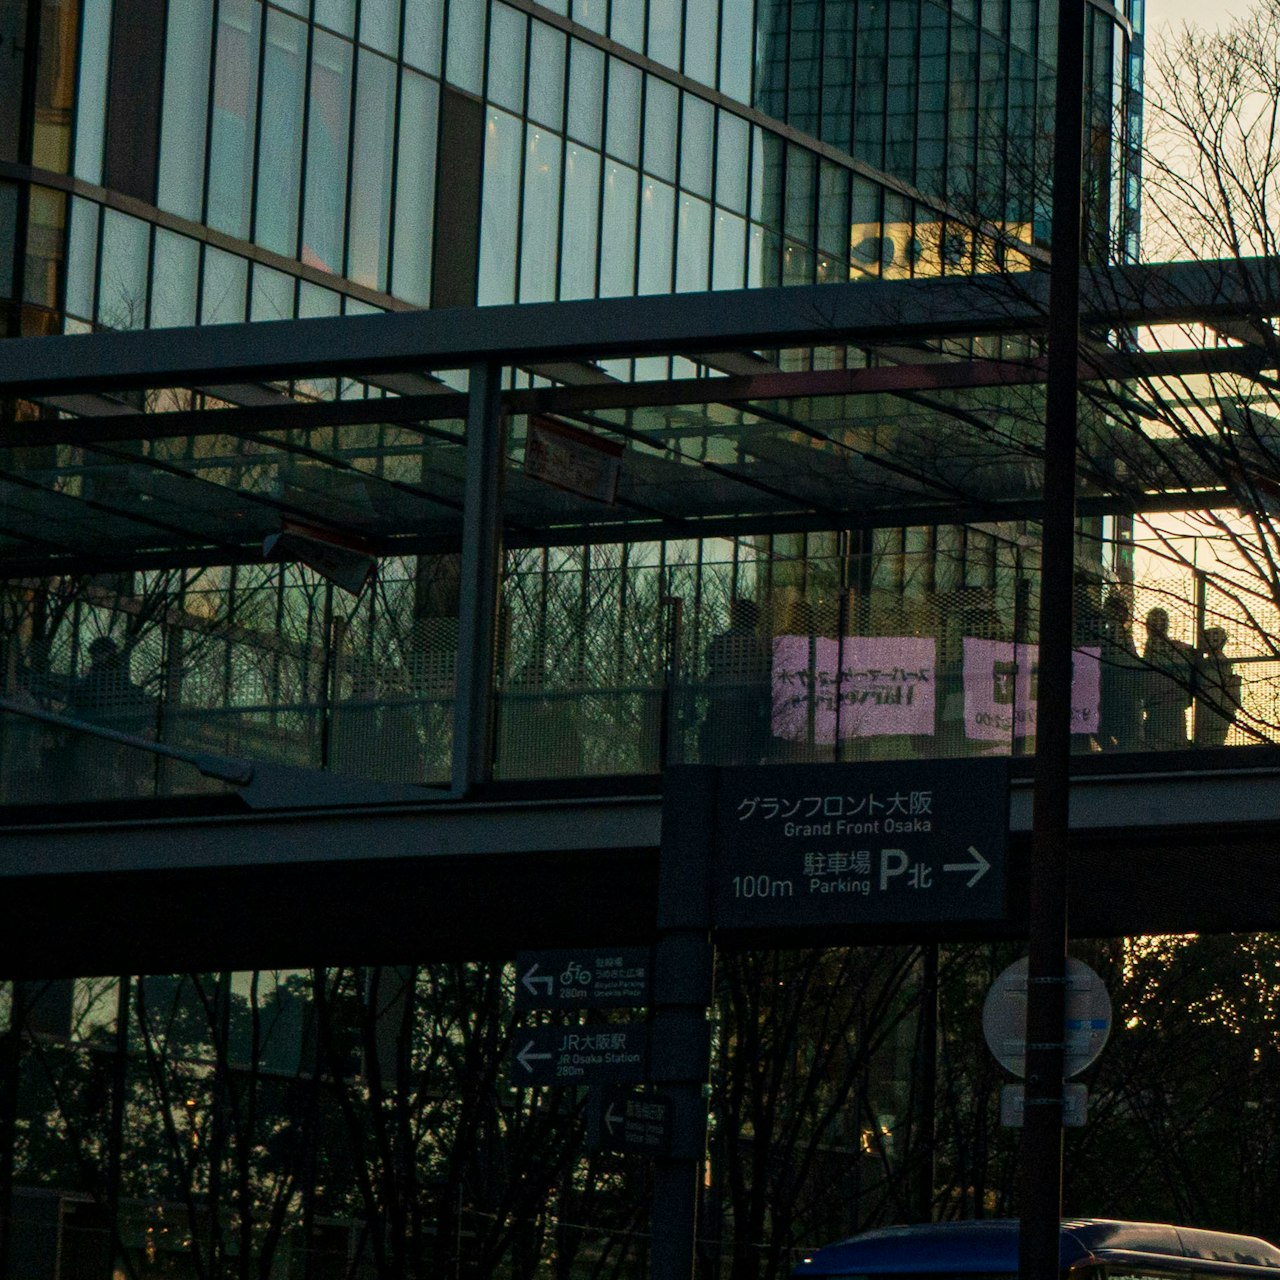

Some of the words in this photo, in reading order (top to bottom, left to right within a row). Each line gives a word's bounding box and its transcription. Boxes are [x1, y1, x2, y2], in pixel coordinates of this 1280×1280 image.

[737, 791, 933, 820] グランフロント大阪
[783, 821, 831, 837] Grand
[836, 819, 879, 835] Front
[883, 818, 931, 833] Osaka
[803, 850, 872, 876] 駐車場
[732, 875, 793, 898] 100m
[810, 876, 871, 896] Parking
[558, 1033, 627, 1052] JR大阪駅
[572, 1053, 603, 1065] Osaka
[604, 1051, 641, 1063] Station
